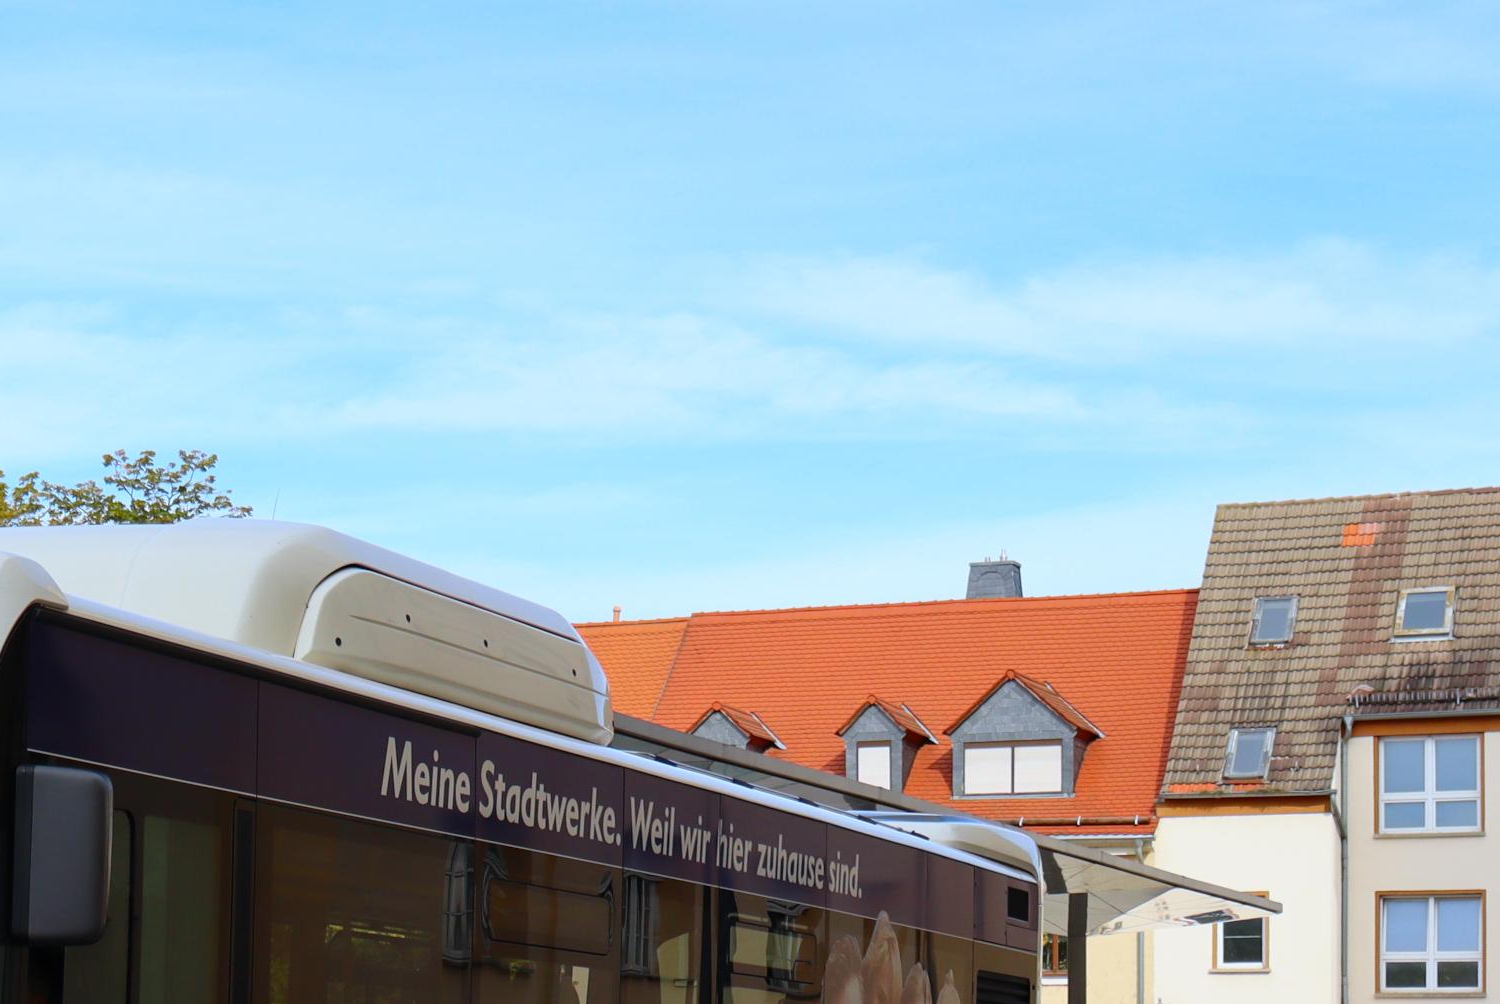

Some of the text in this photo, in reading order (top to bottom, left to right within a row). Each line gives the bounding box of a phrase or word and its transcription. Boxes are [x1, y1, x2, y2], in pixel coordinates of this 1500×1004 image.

[380, 736, 863, 899] Meine Stadtwerke. Weil wir hier zuhause sind.
